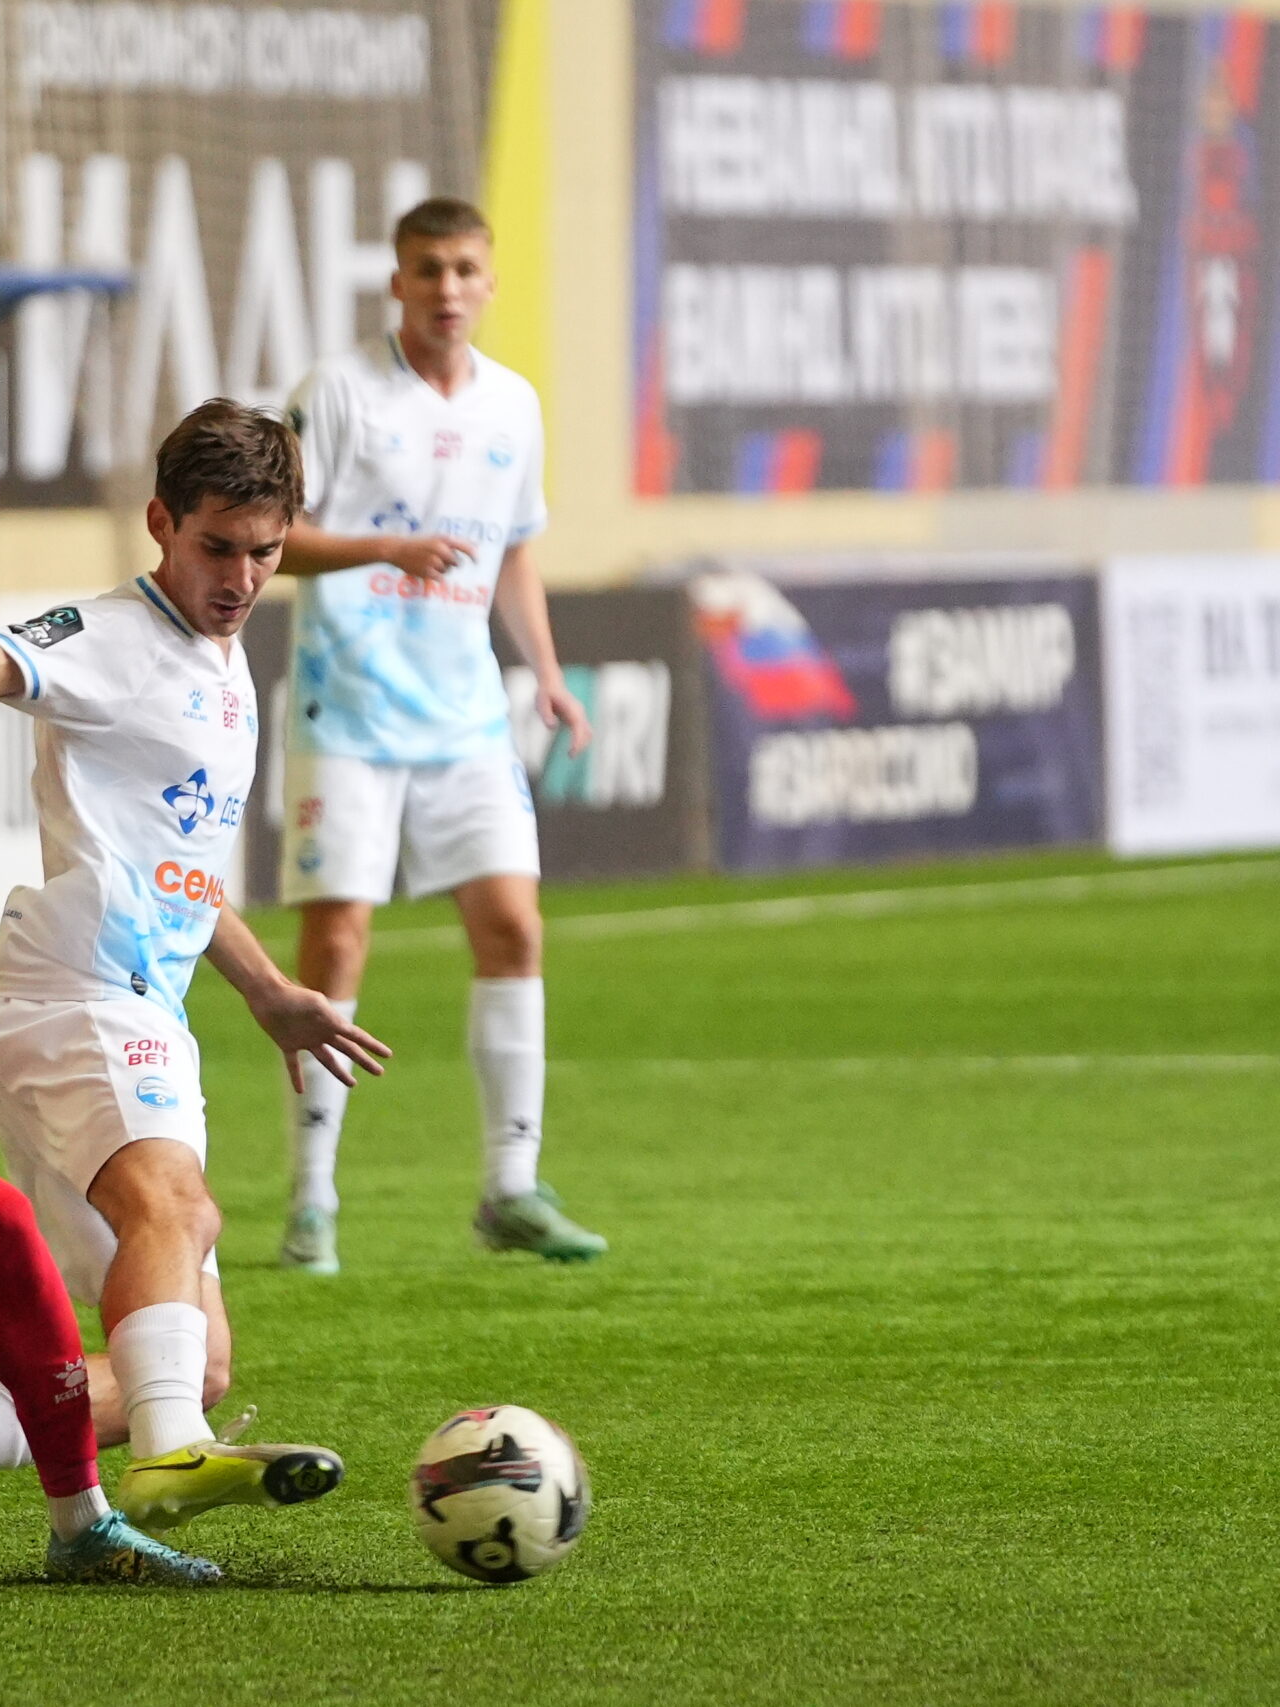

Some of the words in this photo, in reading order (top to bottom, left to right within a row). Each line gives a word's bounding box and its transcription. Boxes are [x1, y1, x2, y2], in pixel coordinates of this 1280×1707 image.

[220, 796, 245, 828] ДЕ
[124, 1039, 168, 1054] FON
[128, 1052, 171, 1067] BET
